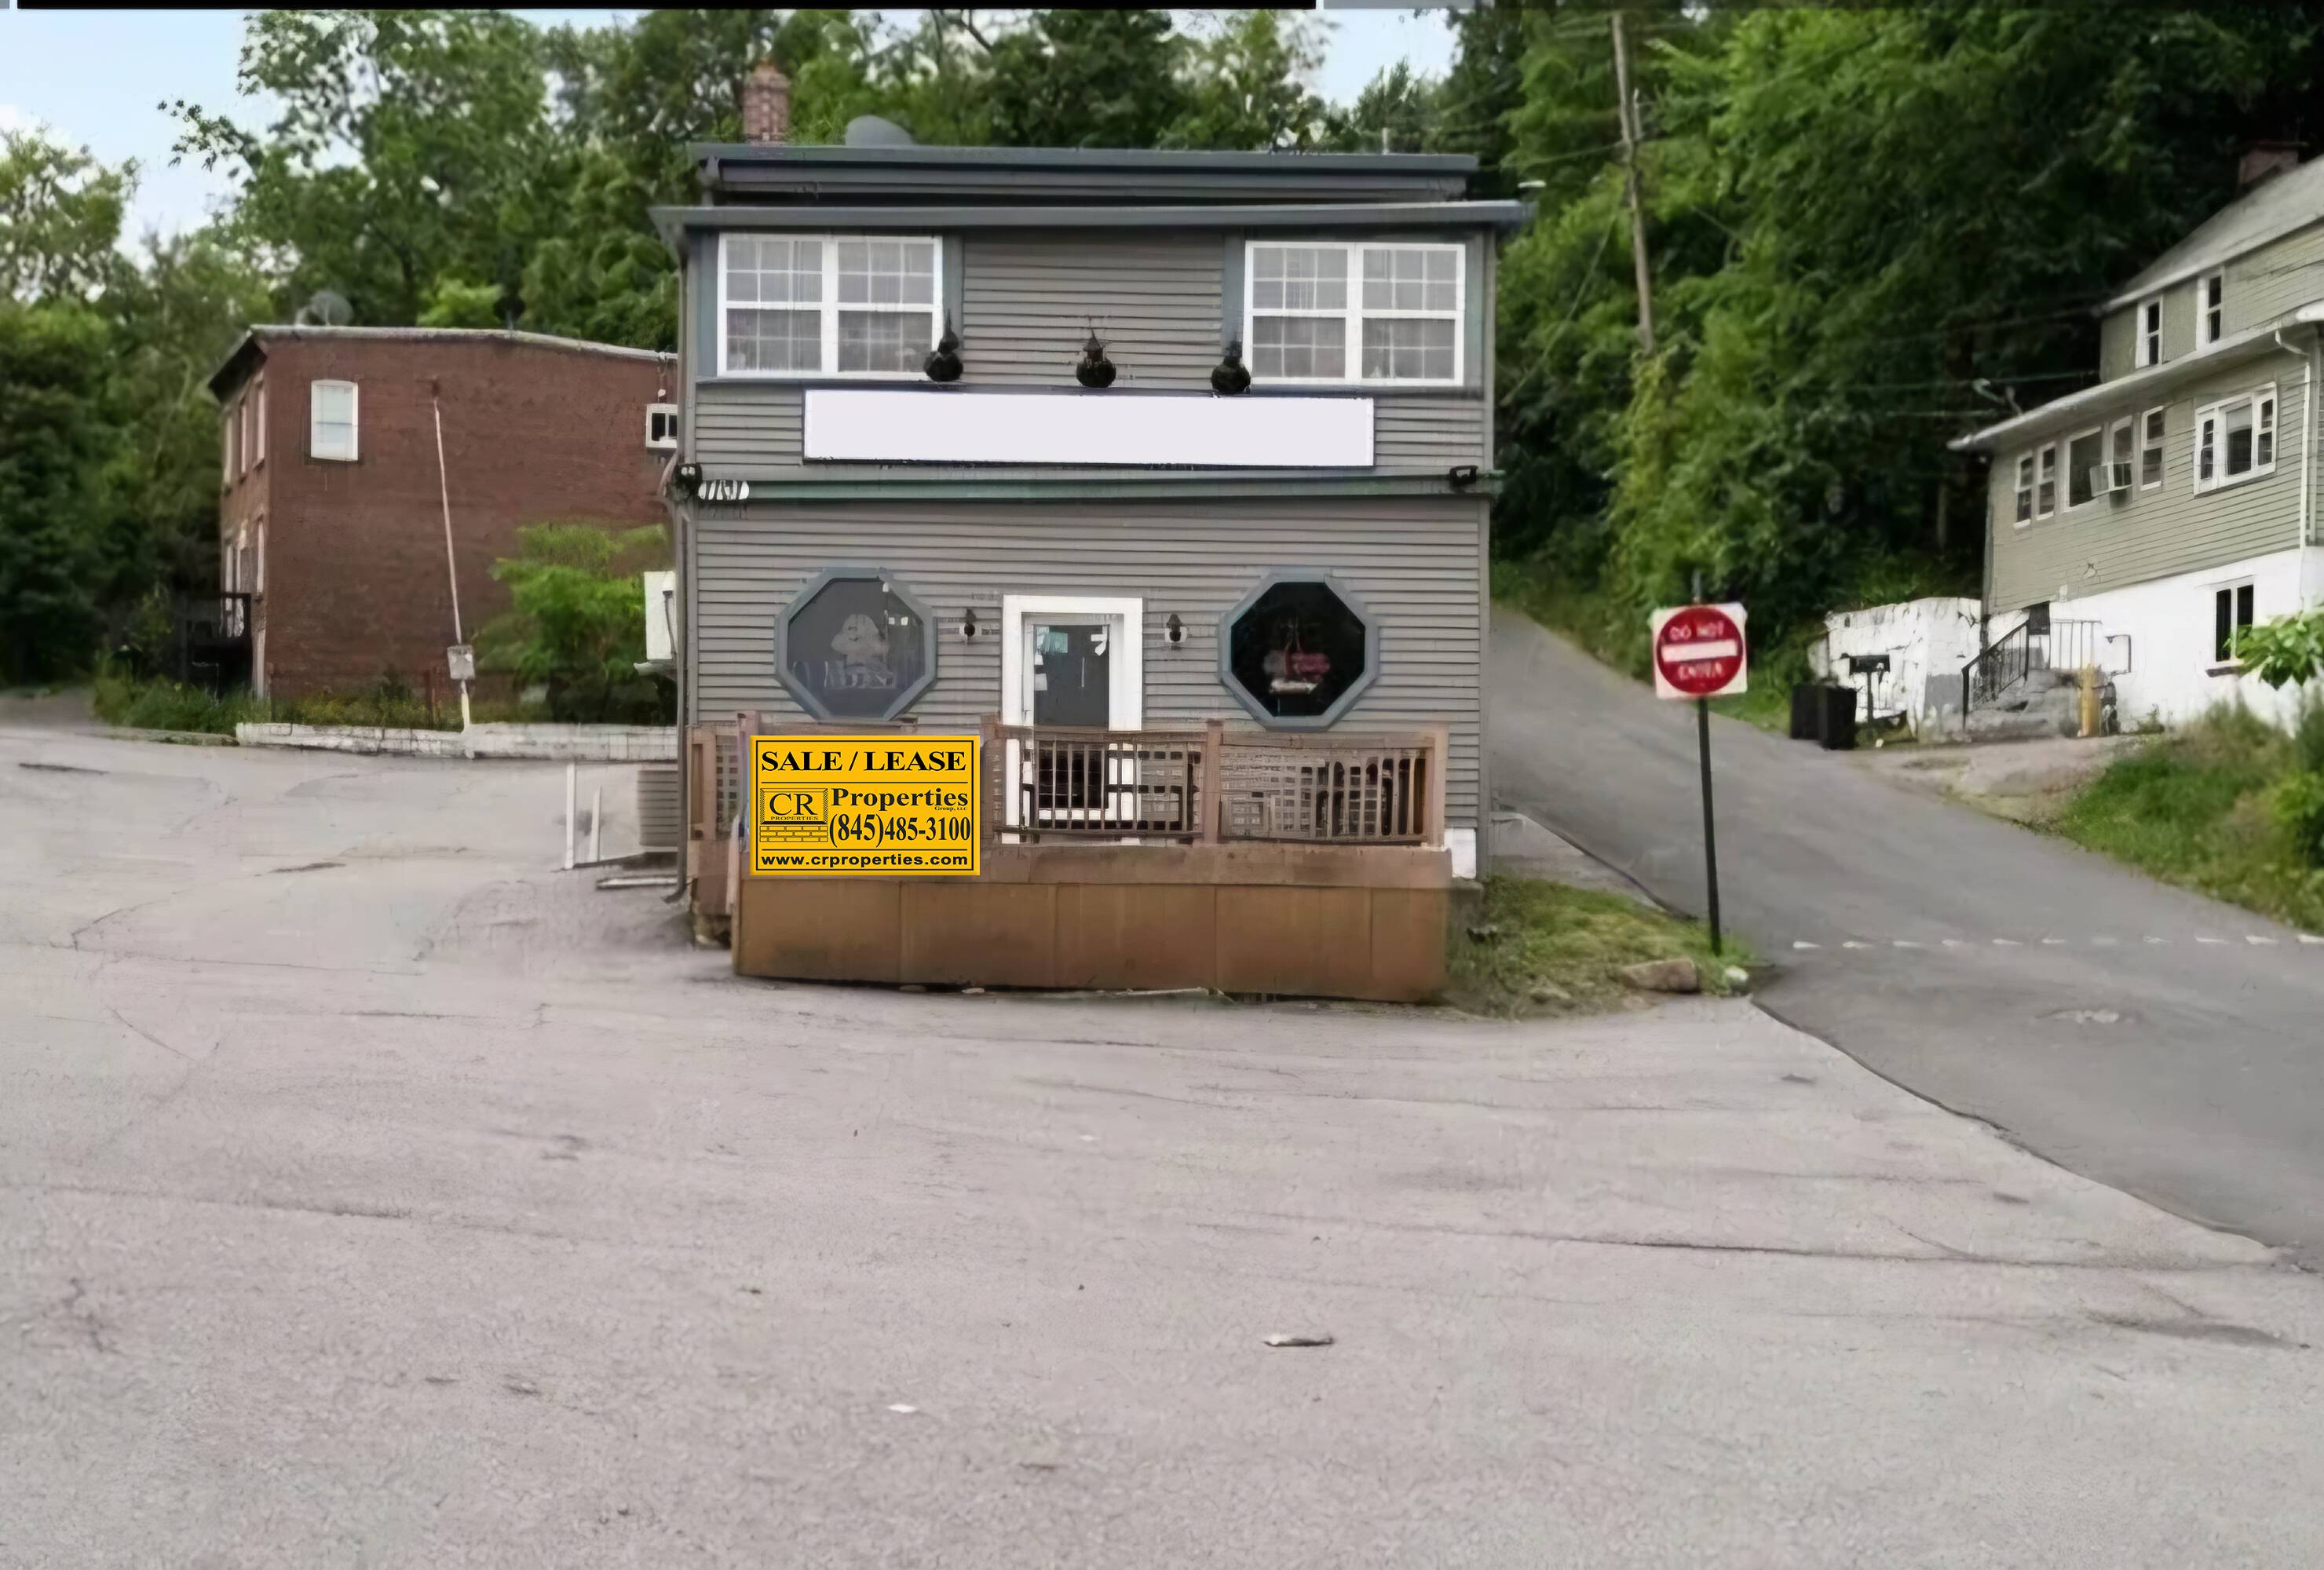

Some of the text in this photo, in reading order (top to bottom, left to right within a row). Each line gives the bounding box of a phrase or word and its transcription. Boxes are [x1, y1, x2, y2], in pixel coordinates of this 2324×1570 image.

[762, 751, 843, 772] SALE
[864, 751, 967, 772] LEASE
[769, 793, 818, 816] CR
[831, 787, 969, 812] Properties
[761, 853, 968, 868] www.crproperties.com
